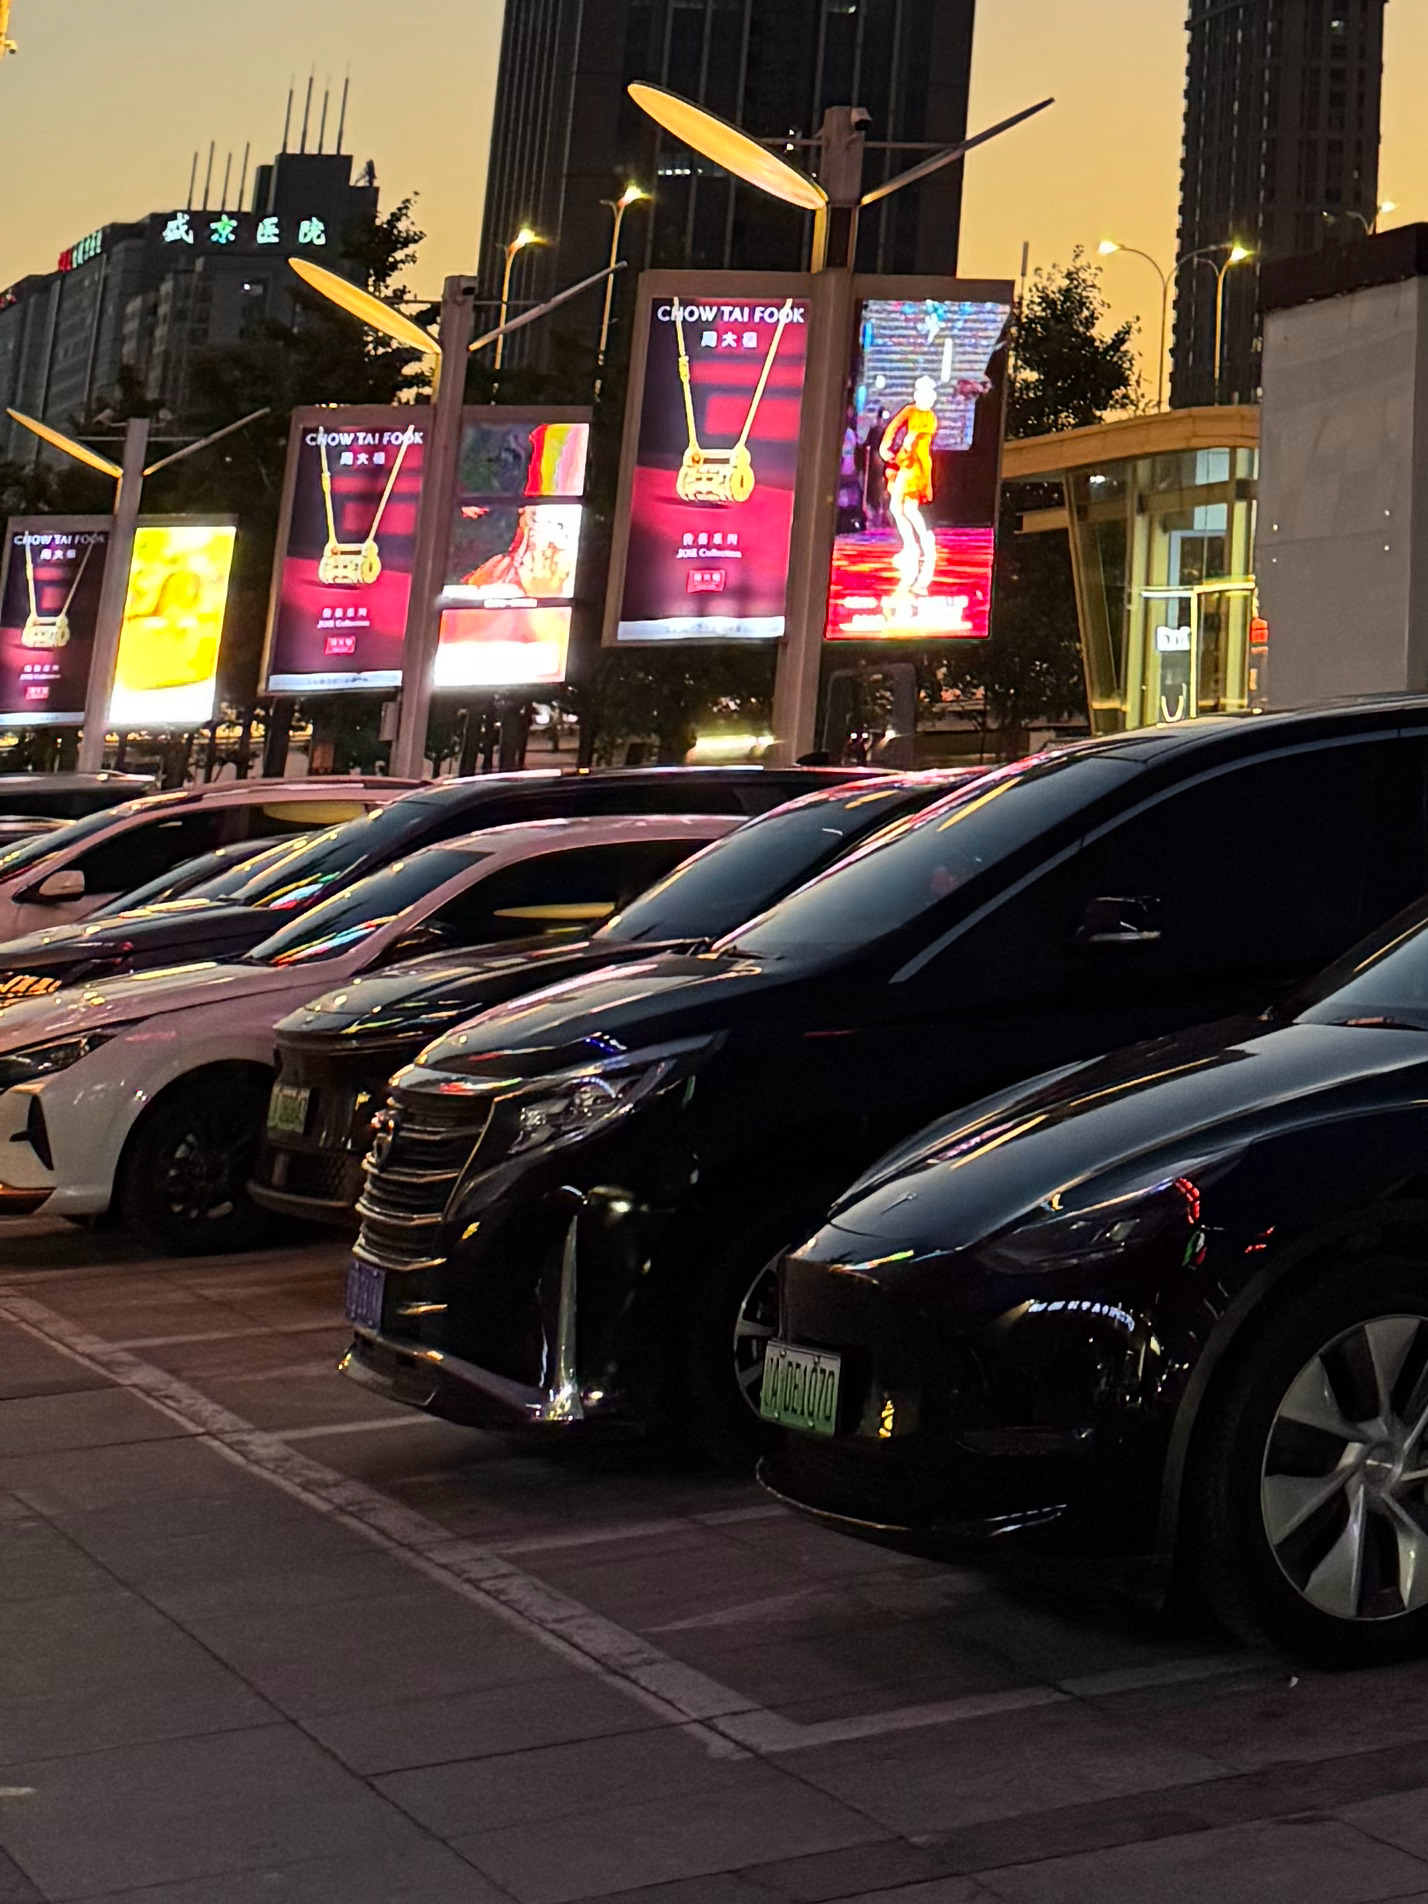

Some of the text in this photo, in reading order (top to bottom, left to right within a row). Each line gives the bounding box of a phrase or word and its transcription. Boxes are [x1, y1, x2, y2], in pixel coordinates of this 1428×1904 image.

[162, 211, 326, 245] 盛京医院
[657, 305, 805, 324] CHOW TAI FOOK
[305, 432, 355, 446] CHOW
[356, 432, 379, 446] TAI
